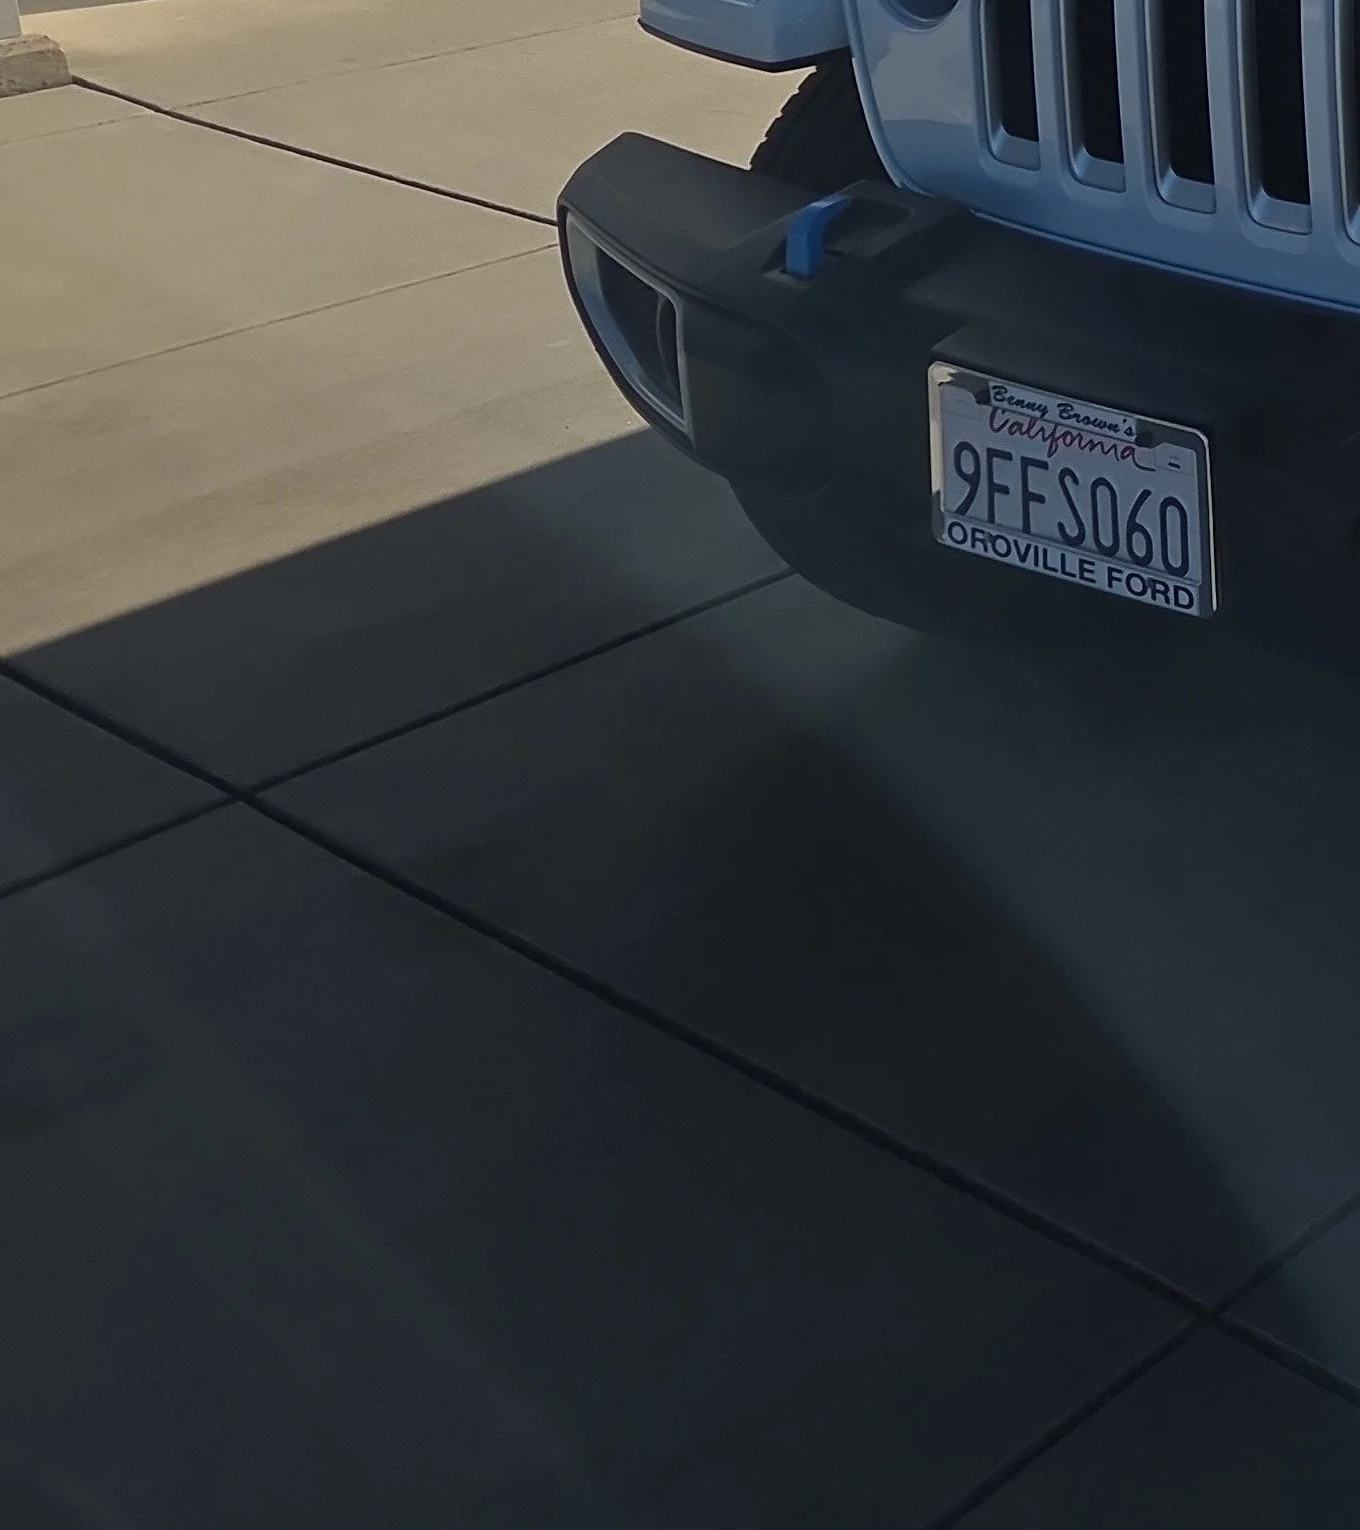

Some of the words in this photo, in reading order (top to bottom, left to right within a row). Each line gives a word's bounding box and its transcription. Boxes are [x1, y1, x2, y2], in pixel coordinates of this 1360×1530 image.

[988, 406, 1157, 472] California
[991, 385, 1049, 418] Benny
[1056, 402, 1136, 437] Brown's
[953, 440, 1190, 579] 9FFS060
[948, 520, 1096, 585] OROVILLE
[1106, 566, 1195, 611] FORD
